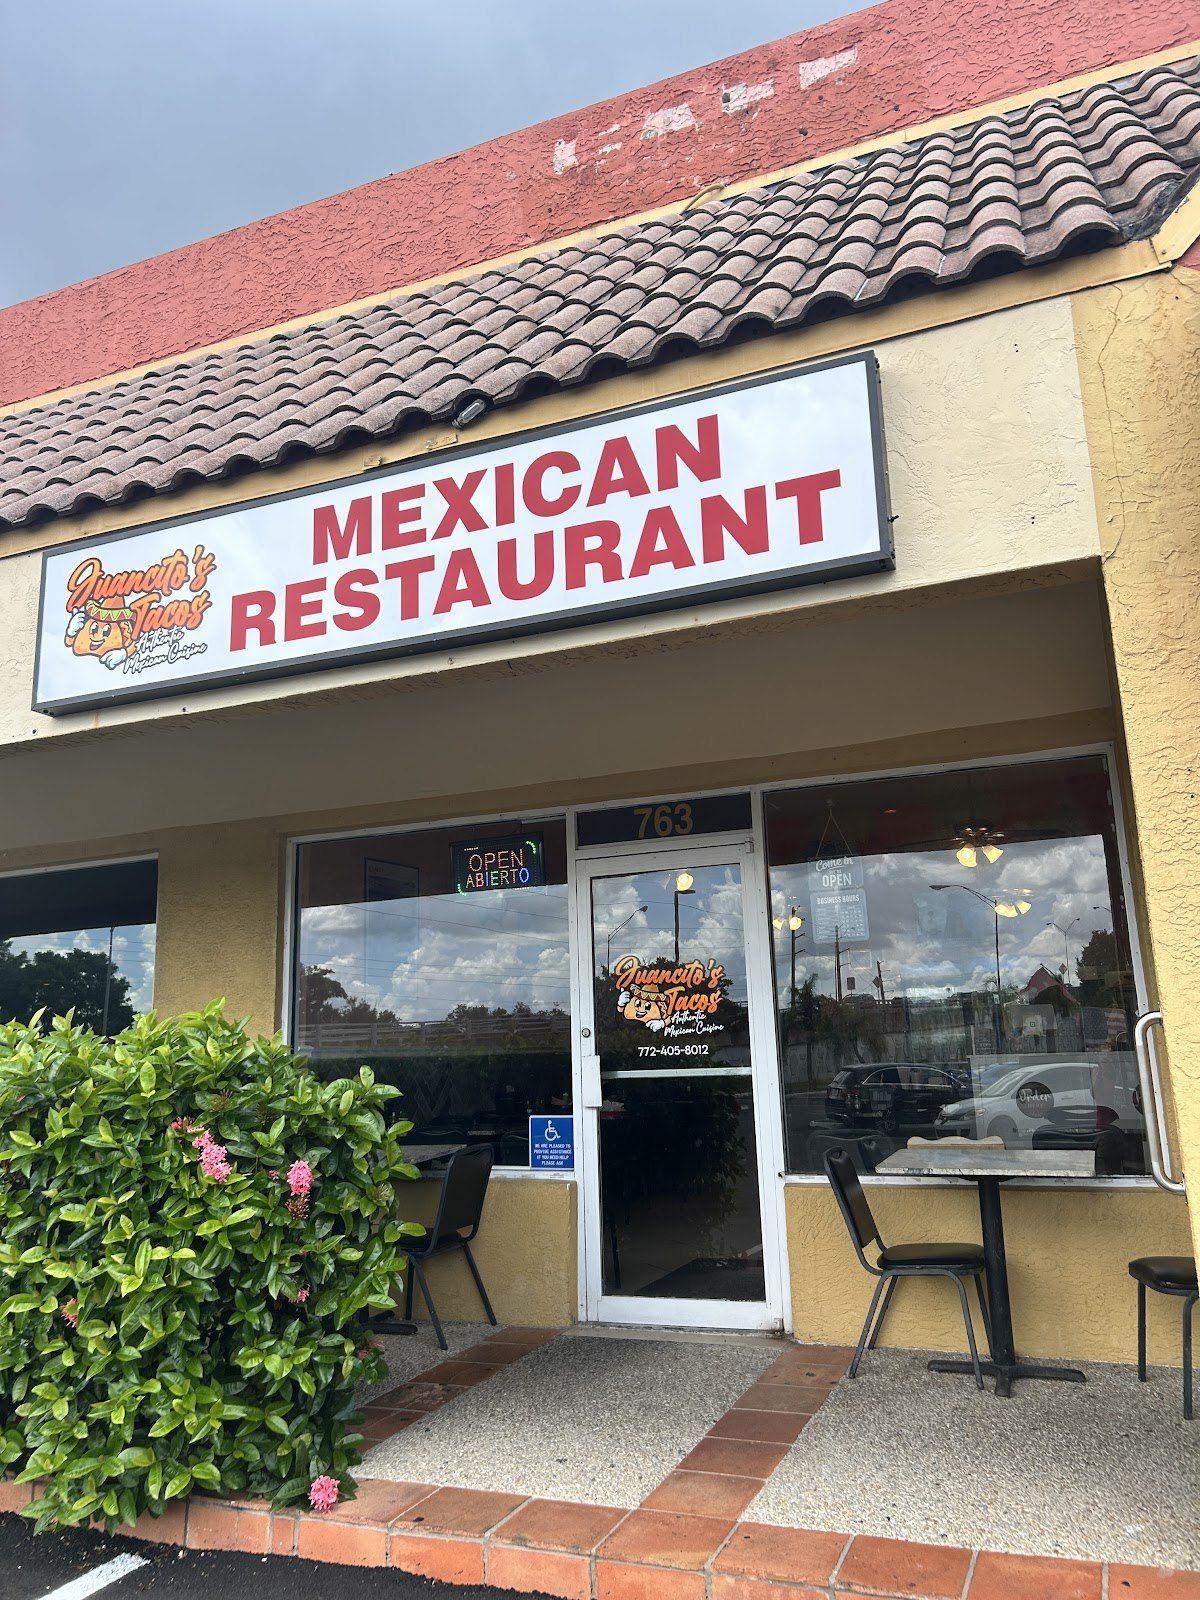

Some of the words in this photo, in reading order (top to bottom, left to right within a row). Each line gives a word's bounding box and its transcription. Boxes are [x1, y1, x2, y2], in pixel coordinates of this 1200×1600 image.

[312, 414, 722, 566] MEXICAN
[229, 469, 841, 652] RESTAURANT
[66, 545, 216, 613] Juancito's
[131, 591, 212, 641] Tacos
[123, 652, 168, 674] Mexican
[168, 641, 208, 664] Cuisine
[633, 802, 694, 839] 763
[469, 848, 524, 871] OPEN
[816, 858, 843, 872] Come
[465, 867, 530, 889] ABIERTO
[822, 872, 852, 887] OPEN
[816, 896, 842, 905] BUSINESS
[842, 894, 860, 903] HOURS
[614, 955, 725, 990] Juancito's
[663, 985, 724, 1015] Tacos
[663, 1023, 696, 1038] Mexican
[695, 1020, 725, 1035] Cuisine
[671, 1009, 707, 1025] Authentic
[637, 1044, 710, 1058] 772-405-8012
